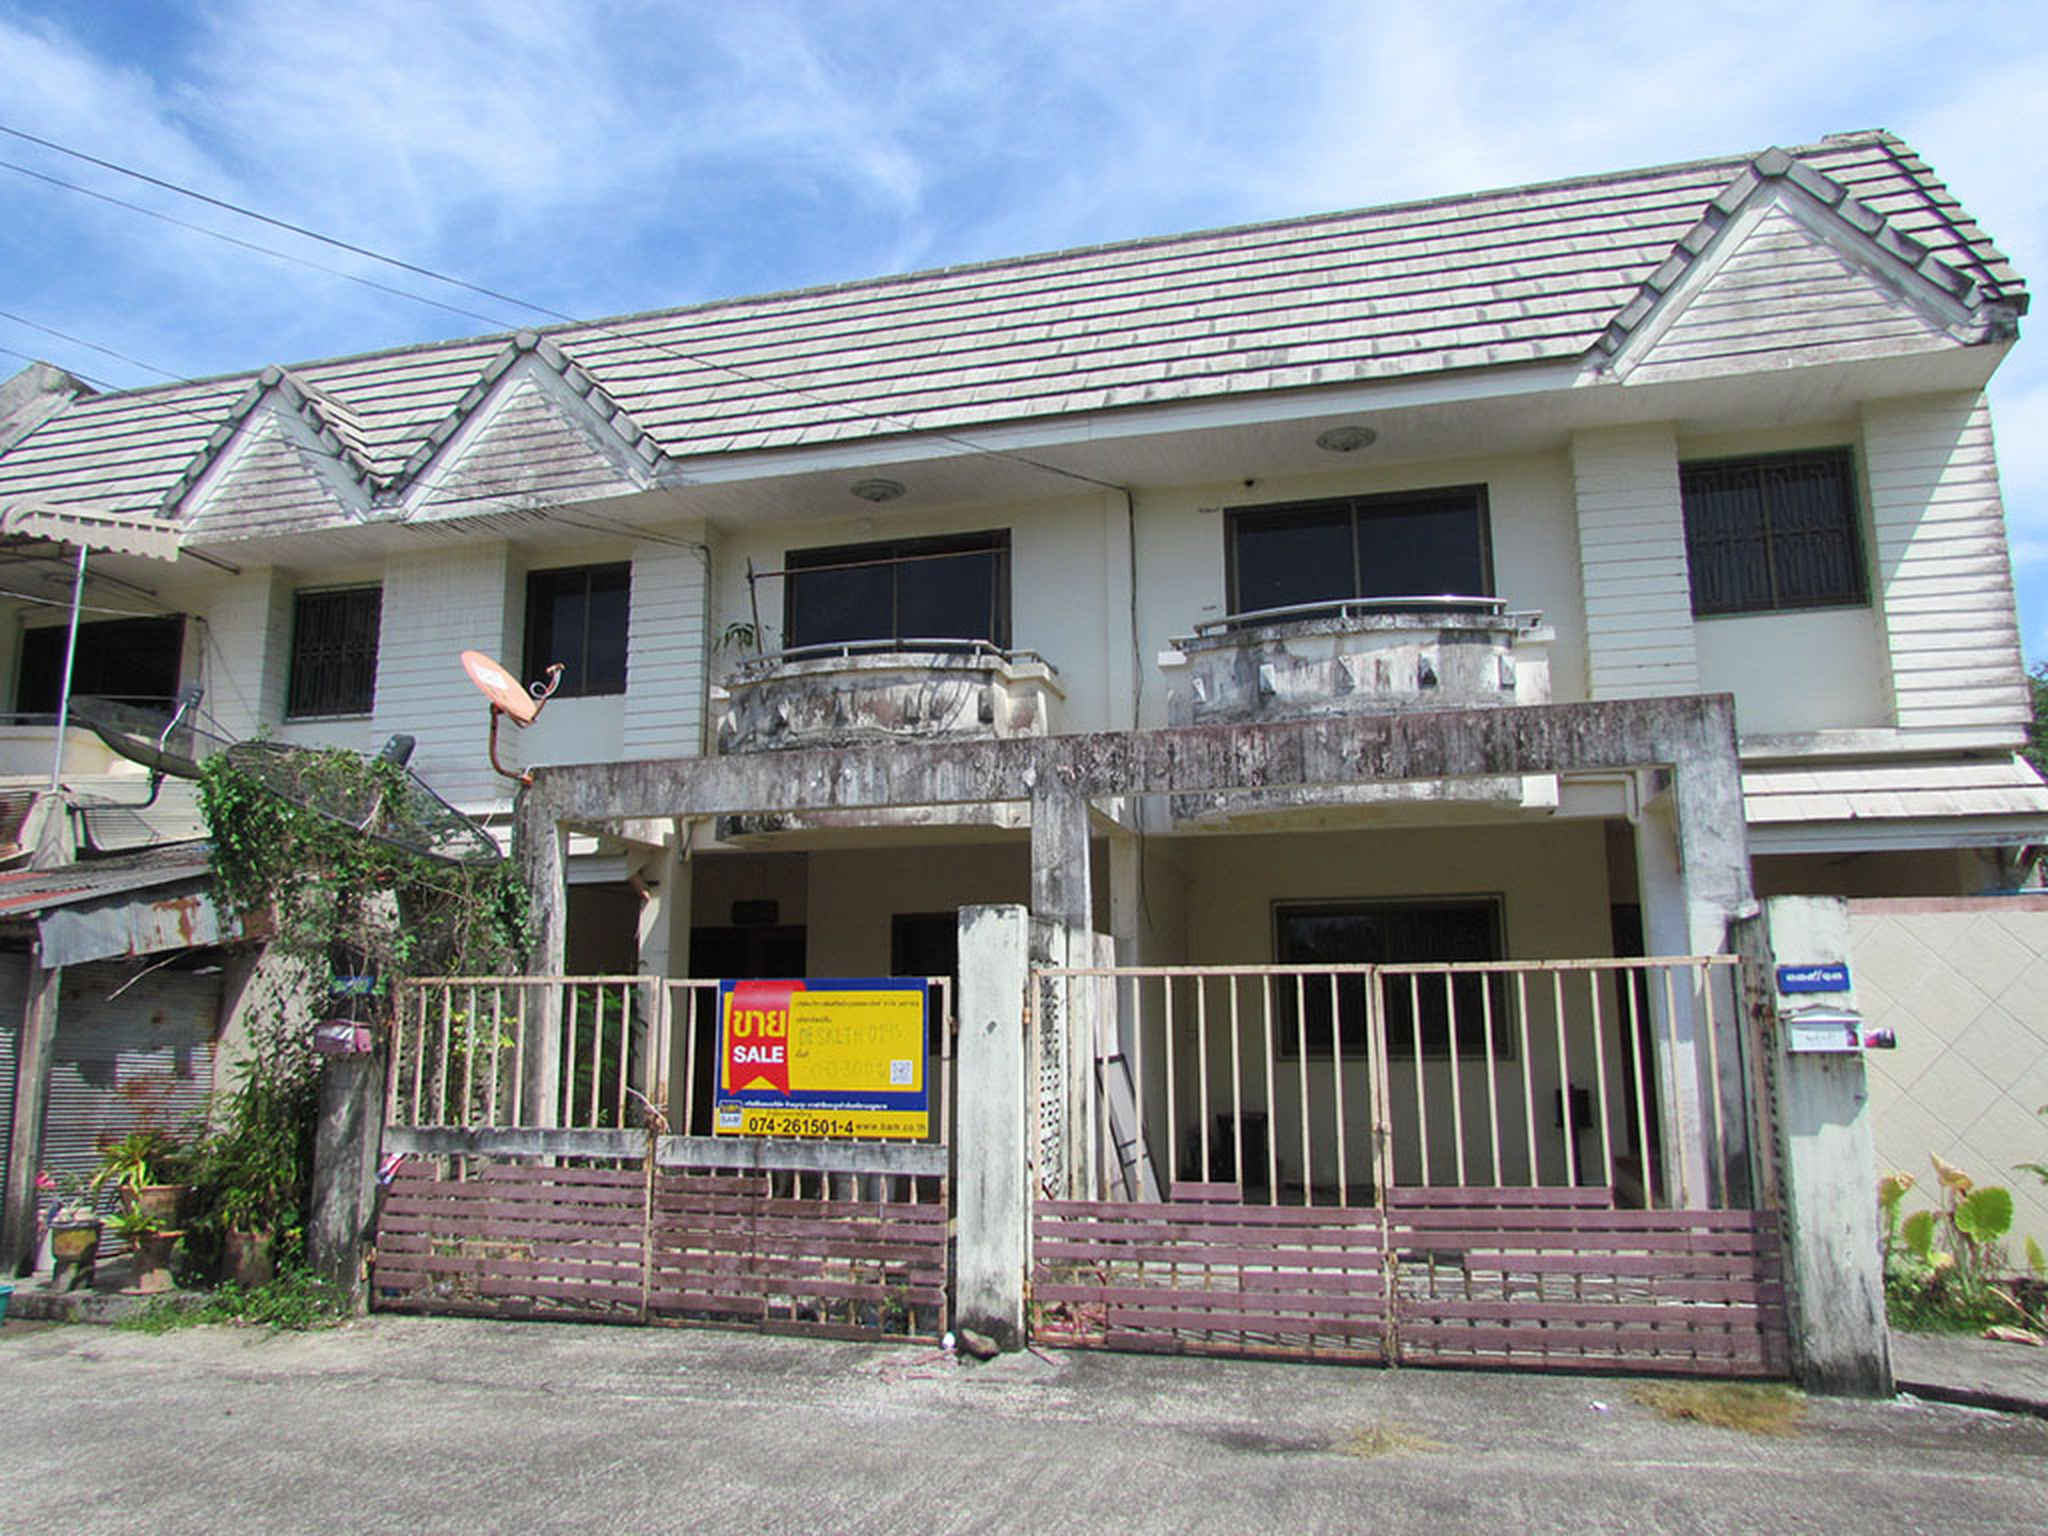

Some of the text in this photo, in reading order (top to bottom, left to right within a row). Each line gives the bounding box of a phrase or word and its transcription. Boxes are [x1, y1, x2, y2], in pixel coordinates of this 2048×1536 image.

[733, 1009, 786, 1038] ขาย
[732, 1045, 784, 1063] SALE
[749, 1117, 854, 1134] 074-261501-4
